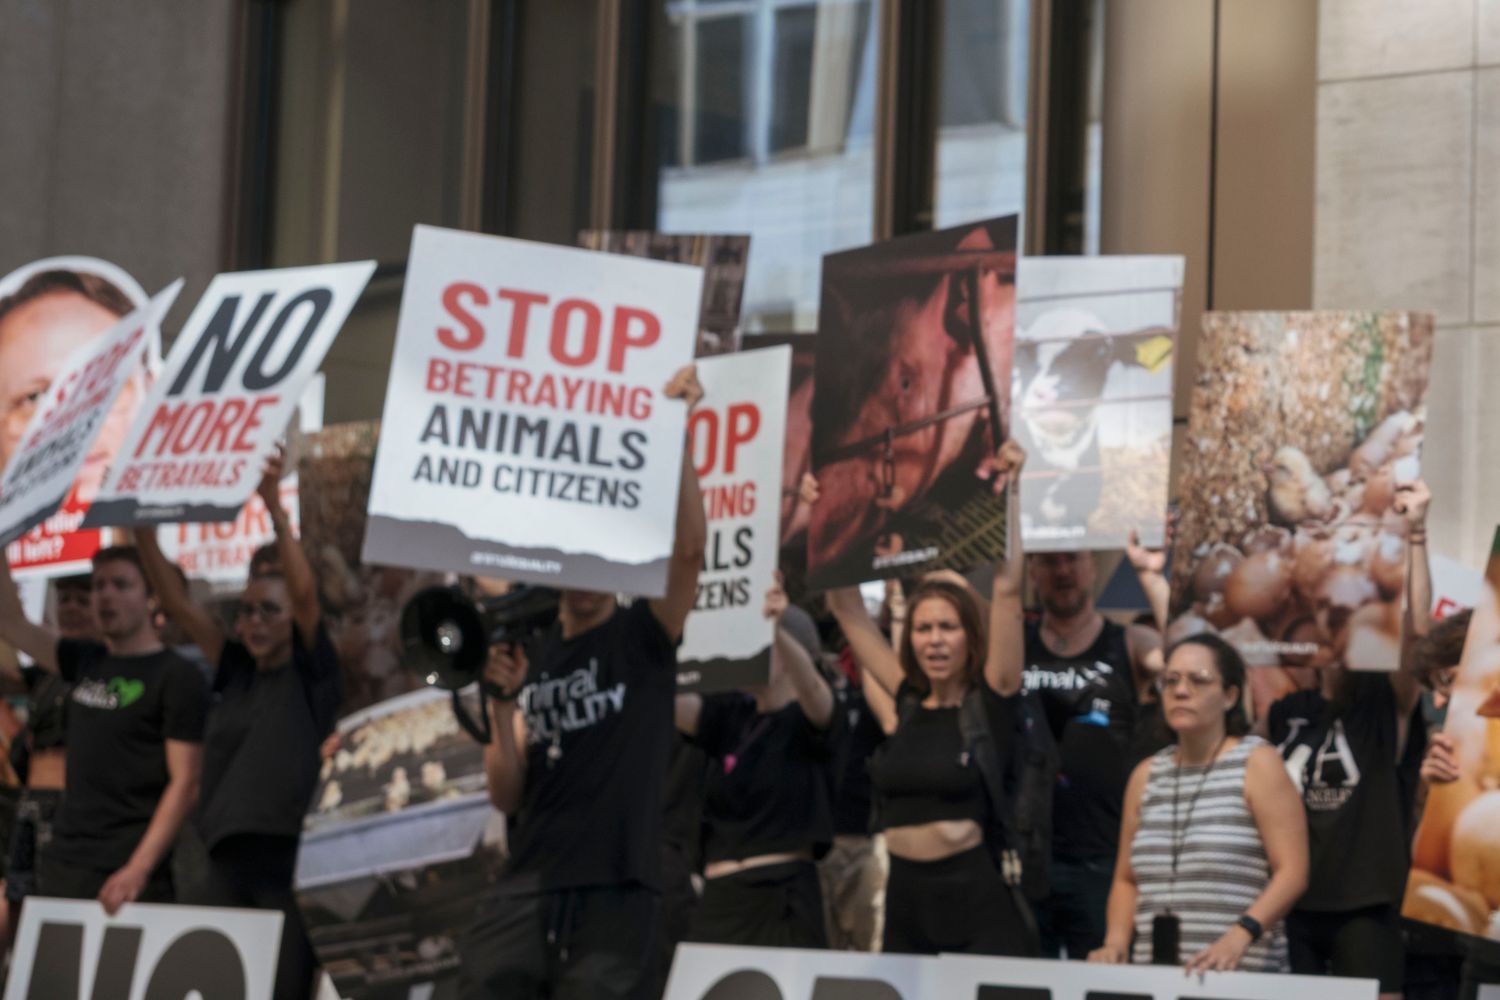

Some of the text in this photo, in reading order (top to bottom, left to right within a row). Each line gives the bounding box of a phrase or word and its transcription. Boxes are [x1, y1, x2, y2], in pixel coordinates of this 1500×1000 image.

[167, 286, 334, 395] NO
[436, 281, 662, 374] STOP
[425, 358, 653, 421] BETRAYING
[134, 396, 281, 458] MORE
[419, 404, 649, 471] ANIMALS
[115, 461, 248, 493] BETRAYALS
[413, 455, 642, 510] AND CITIZENS
[700, 481, 757, 521] ING
[702, 526, 754, 572] LS
